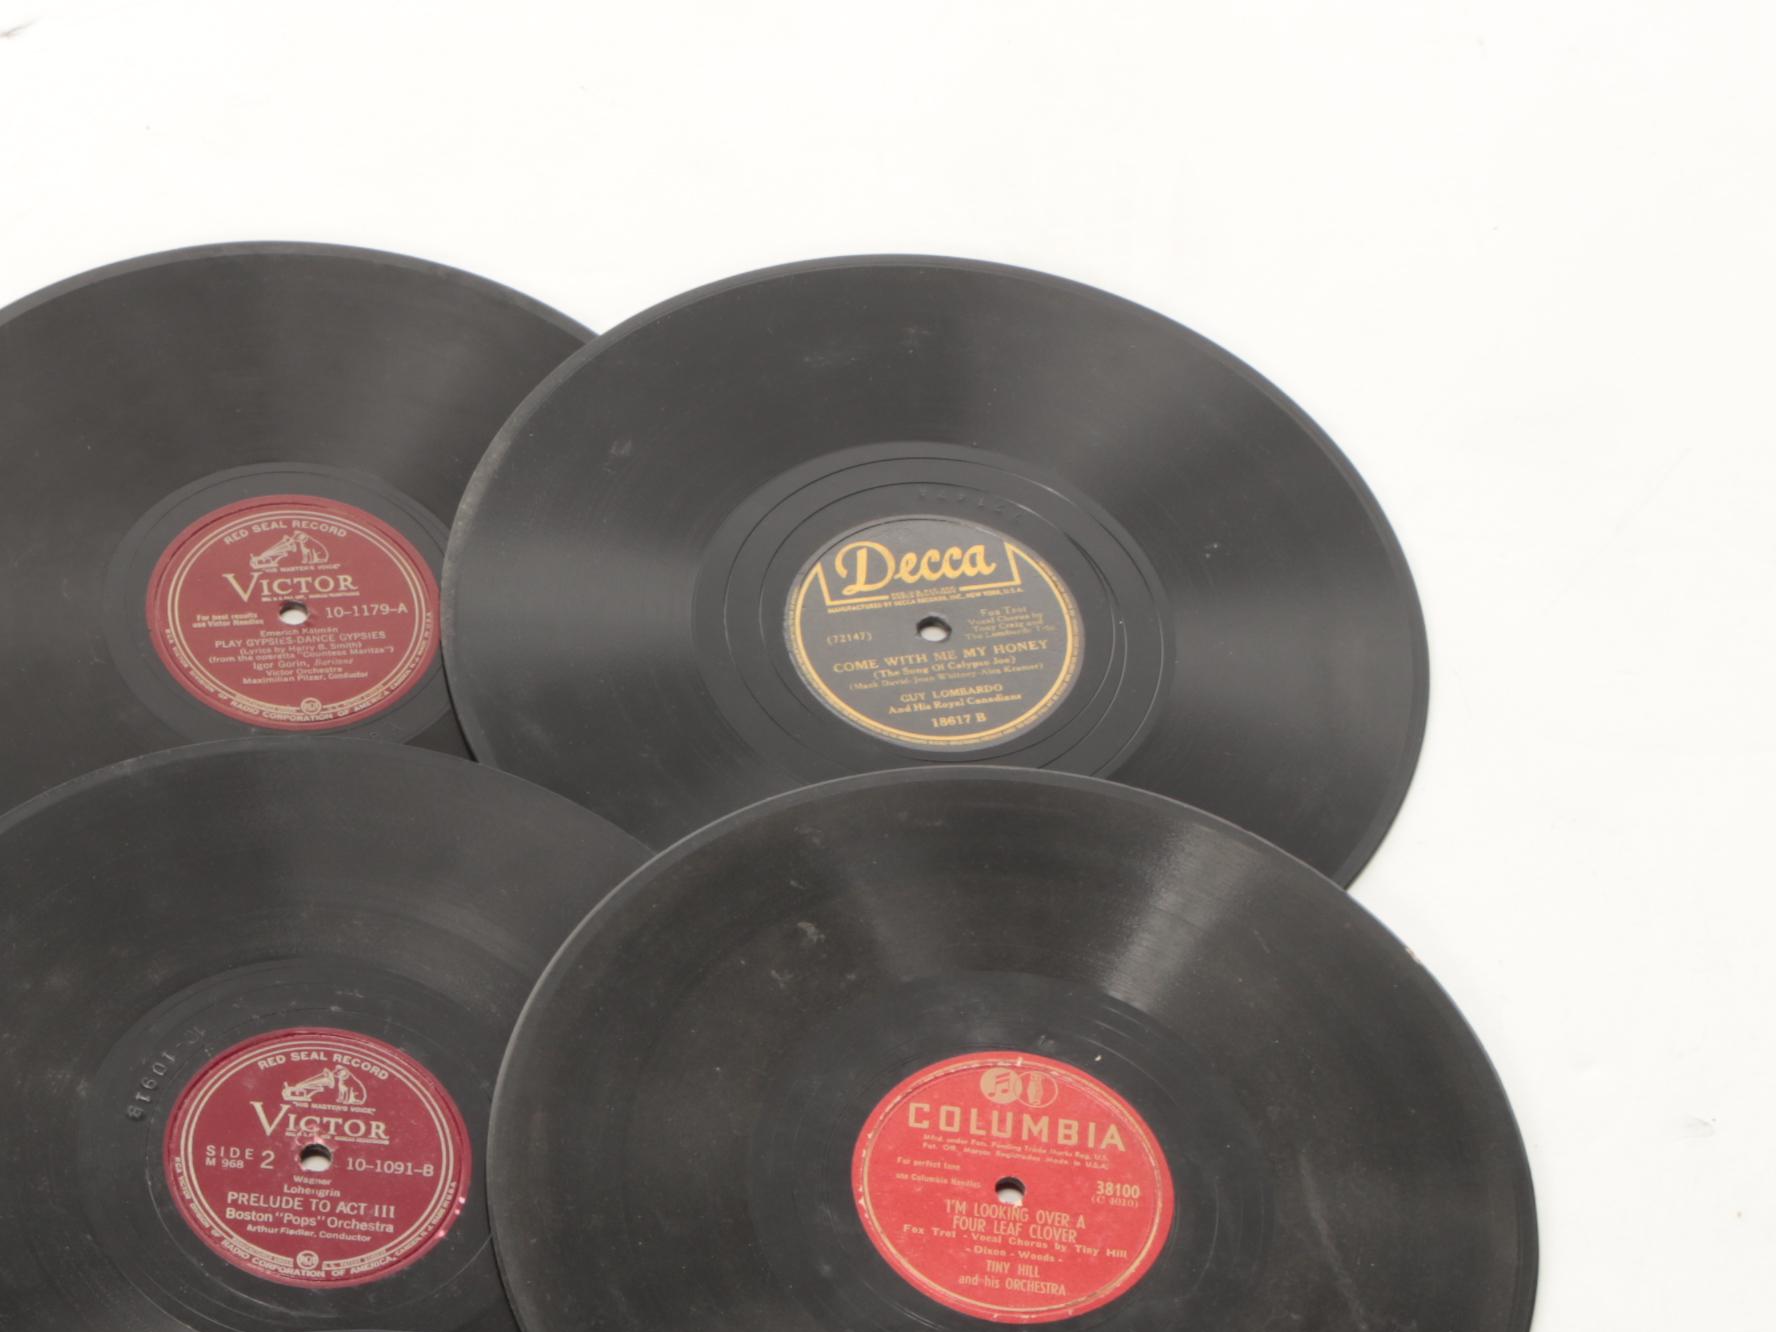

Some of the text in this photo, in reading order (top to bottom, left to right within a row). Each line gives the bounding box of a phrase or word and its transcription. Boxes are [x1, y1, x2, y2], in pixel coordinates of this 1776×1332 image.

[225, 520, 346, 544] RED SEAL RECORD
[834, 541, 996, 596] Decca
[222, 572, 358, 602] VICTOR
[326, 603, 408, 618] 10-1179-A
[215, 640, 242, 648] PLAY
[340, 632, 386, 641] GYPSIES
[833, 640, 1048, 672] COME WITH ME MY HONEY
[901, 684, 1003, 703] GUY LOMBARDO
[977, 713, 986, 722] B
[258, 1051, 388, 1080] RED SEAL RECORD
[250, 1101, 389, 1139] VICTOR
[908, 1102, 1125, 1152] COLUMBIA
[207, 1145, 274, 1169] SIDE 2
[347, 1158, 434, 1177] 10-1091-B
[1097, 1181, 1140, 1199] 38100
[228, 1192, 395, 1218] PRELUDE TO ACT III
[945, 1199, 1085, 1229] I'M LOOKING OVER A
[226, 1208, 272, 1222] Boston
[327, 1217, 394, 1233] Orchestra
[953, 1216, 1077, 1243] FOUR LEAF CLOVER
[986, 1260, 1039, 1278] TINY HILL
[959, 1275, 1065, 1296] and his ORCHESTRA
